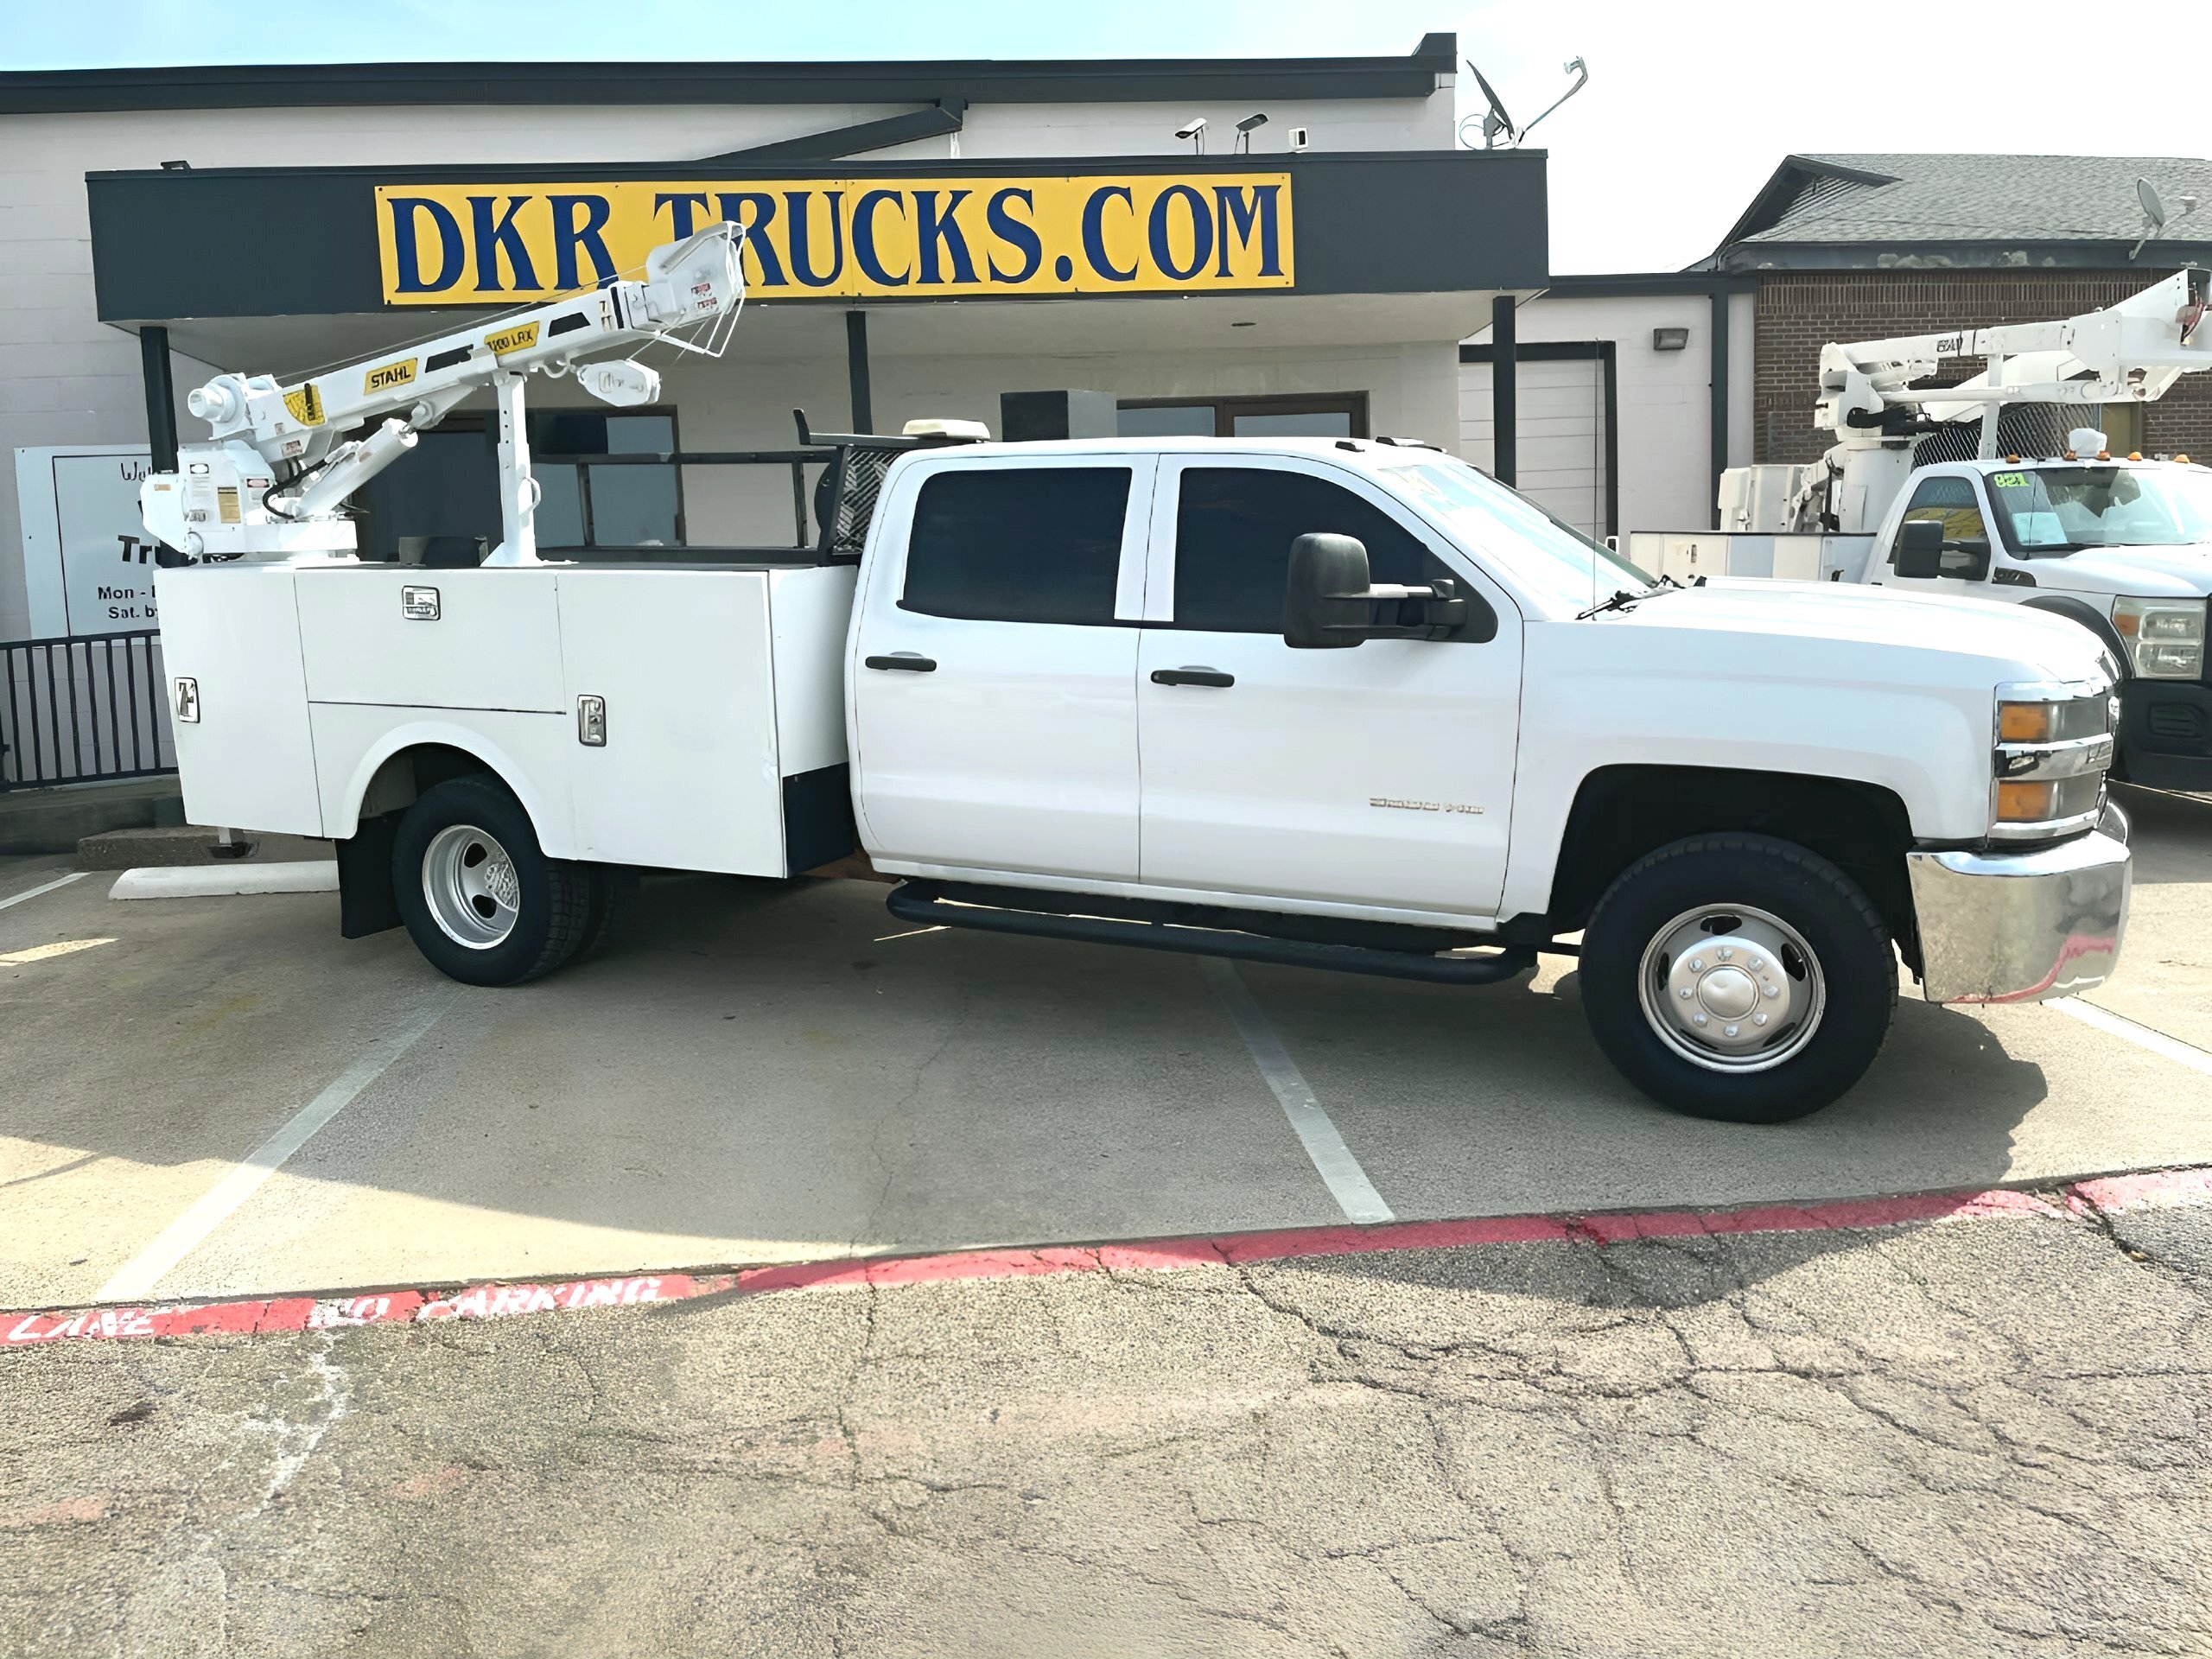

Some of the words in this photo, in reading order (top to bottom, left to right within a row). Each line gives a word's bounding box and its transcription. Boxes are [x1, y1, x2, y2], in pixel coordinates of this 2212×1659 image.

[386, 194, 619, 293] DKR
[653, 184, 1285, 288] TRUCKS.COM
[371, 365, 411, 389] STAHL
[98, 586, 134, 600] Mon
